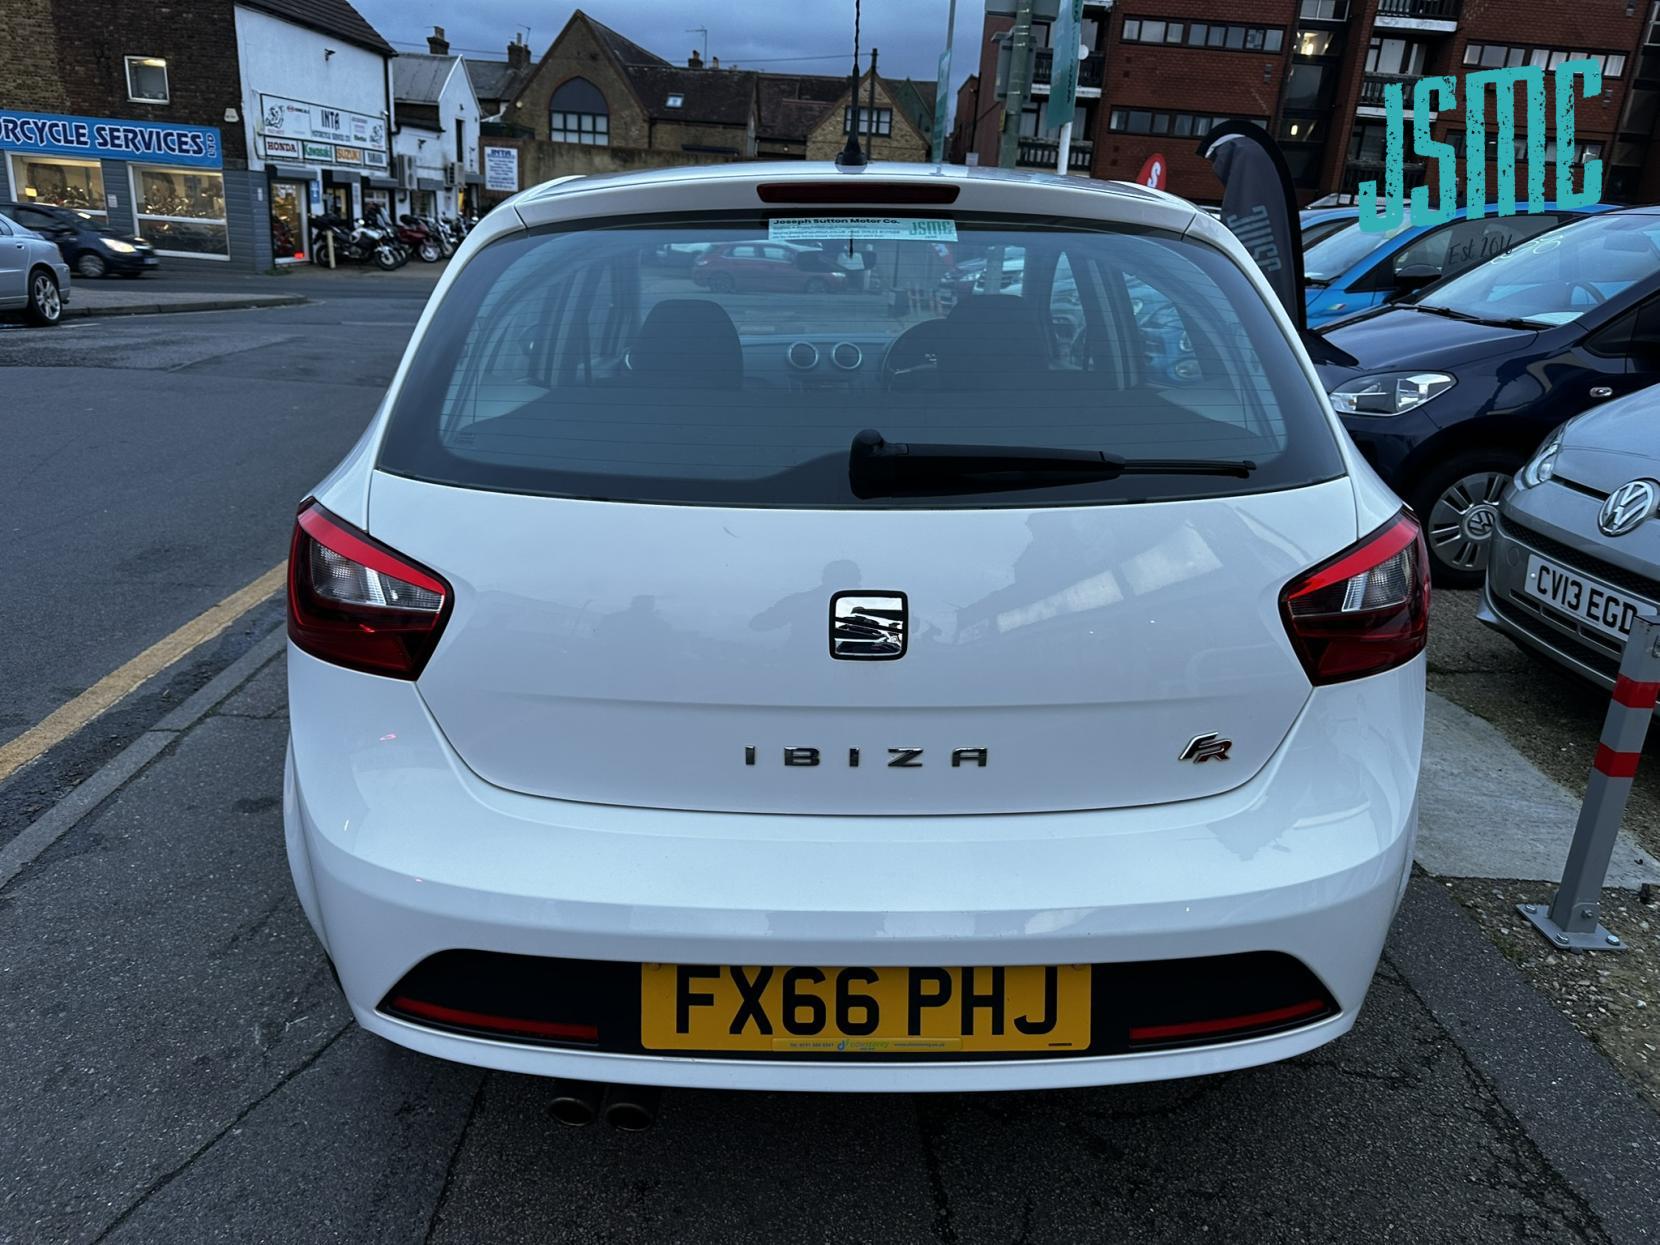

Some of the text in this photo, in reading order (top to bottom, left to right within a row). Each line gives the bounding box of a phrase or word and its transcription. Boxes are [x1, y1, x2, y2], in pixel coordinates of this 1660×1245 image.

[321, 109, 341, 130] INTA
[94, 123, 206, 157] SERVICES
[205, 133, 216, 158] LTD
[267, 141, 297, 153] HONDA
[336, 147, 361, 161] SUZUKI
[773, 218, 812, 226] Joseph
[909, 220, 953, 236] JSMC
[1537, 565, 1638, 635] CV13 EGD
[745, 744, 988, 768] IBIZA
[1178, 731, 1232, 764] FR
[675, 966, 1058, 1036] FX66 PHJ
